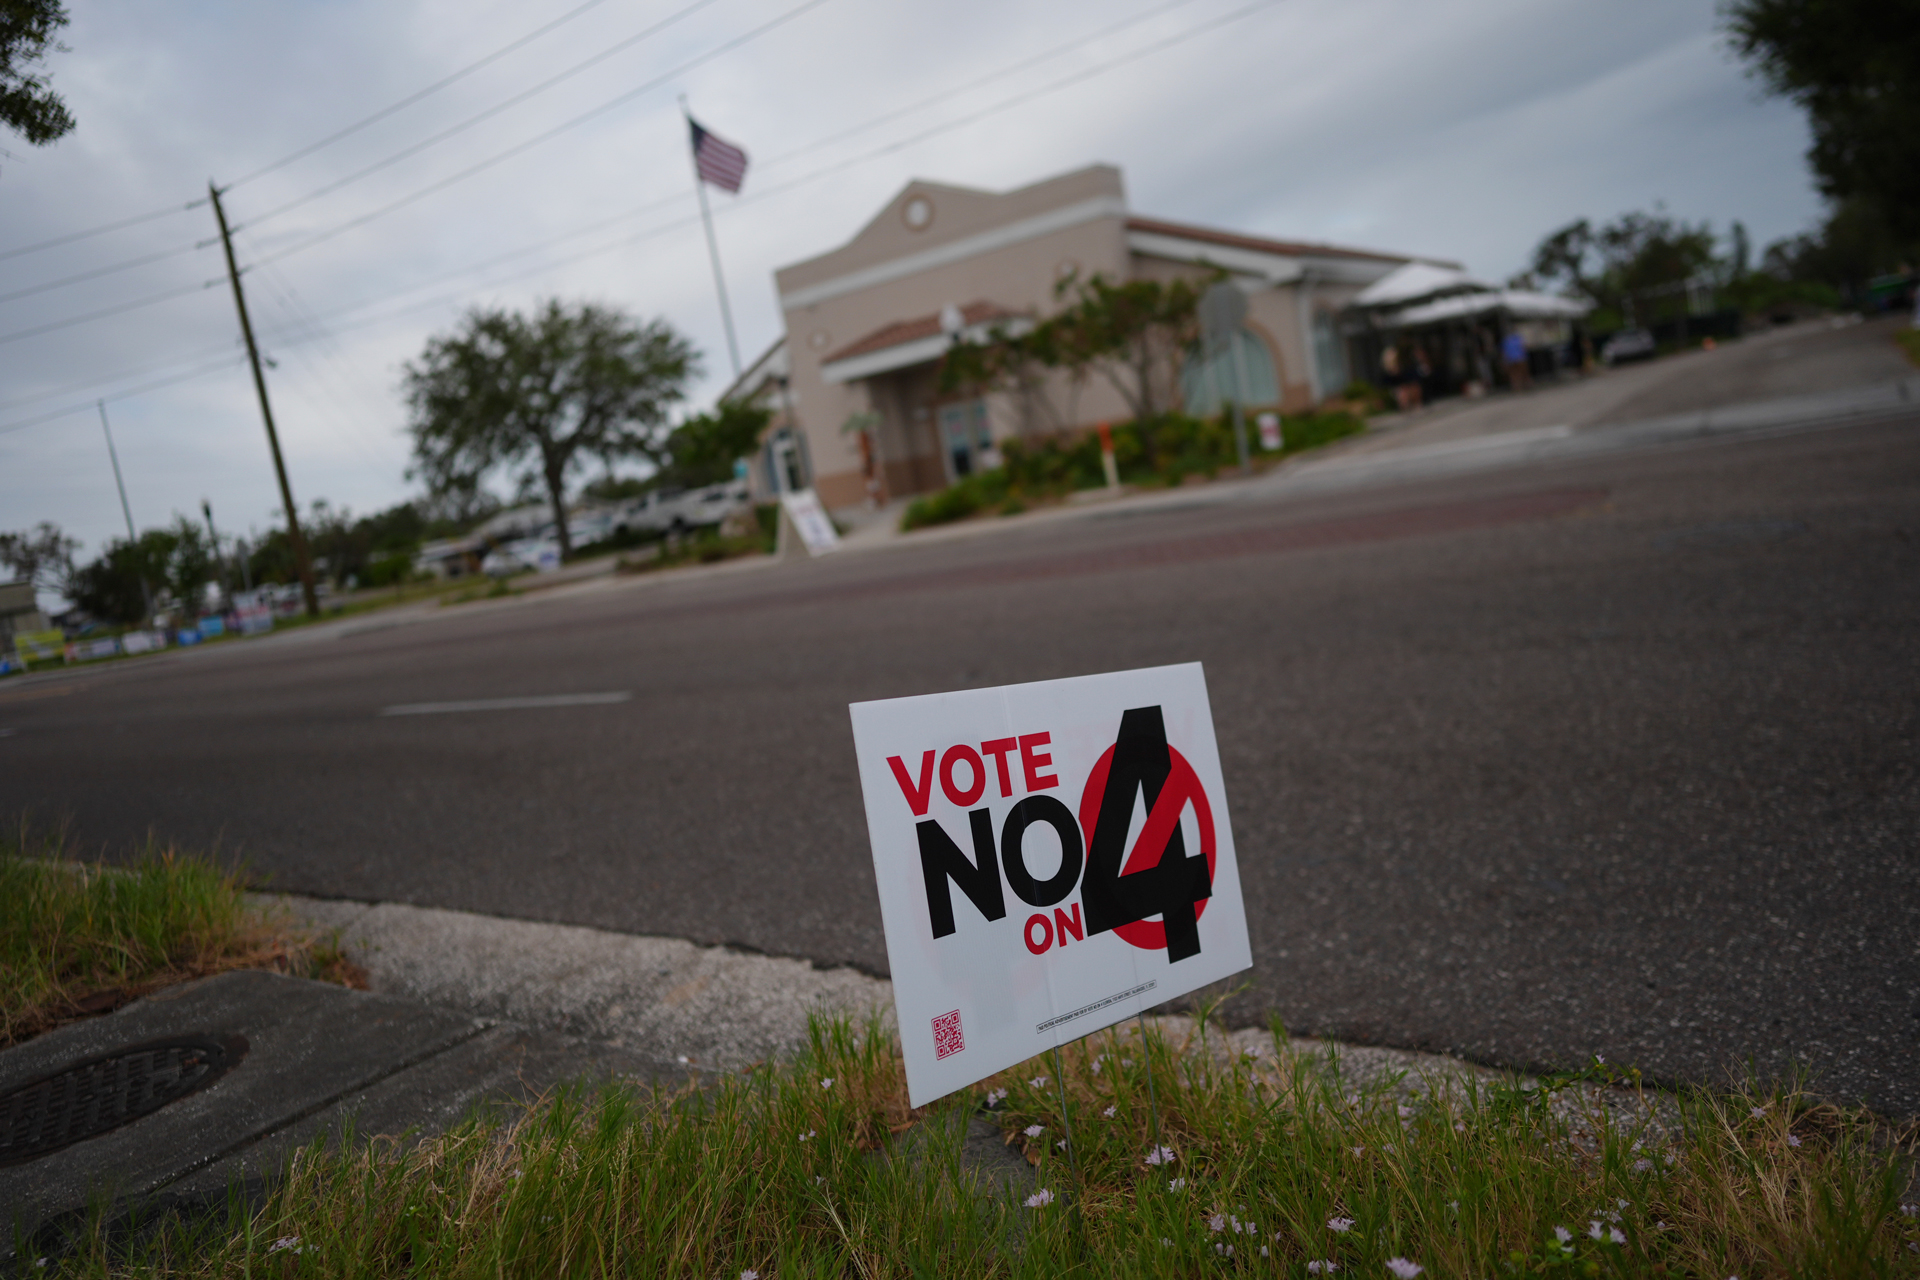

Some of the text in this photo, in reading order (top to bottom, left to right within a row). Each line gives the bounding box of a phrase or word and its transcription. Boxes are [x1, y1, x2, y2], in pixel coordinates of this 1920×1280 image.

[886, 731, 1059, 817] VOTE
[1024, 902, 1084, 955] ON
[1081, 705, 1213, 964] 4
[916, 795, 1083, 940] NO
